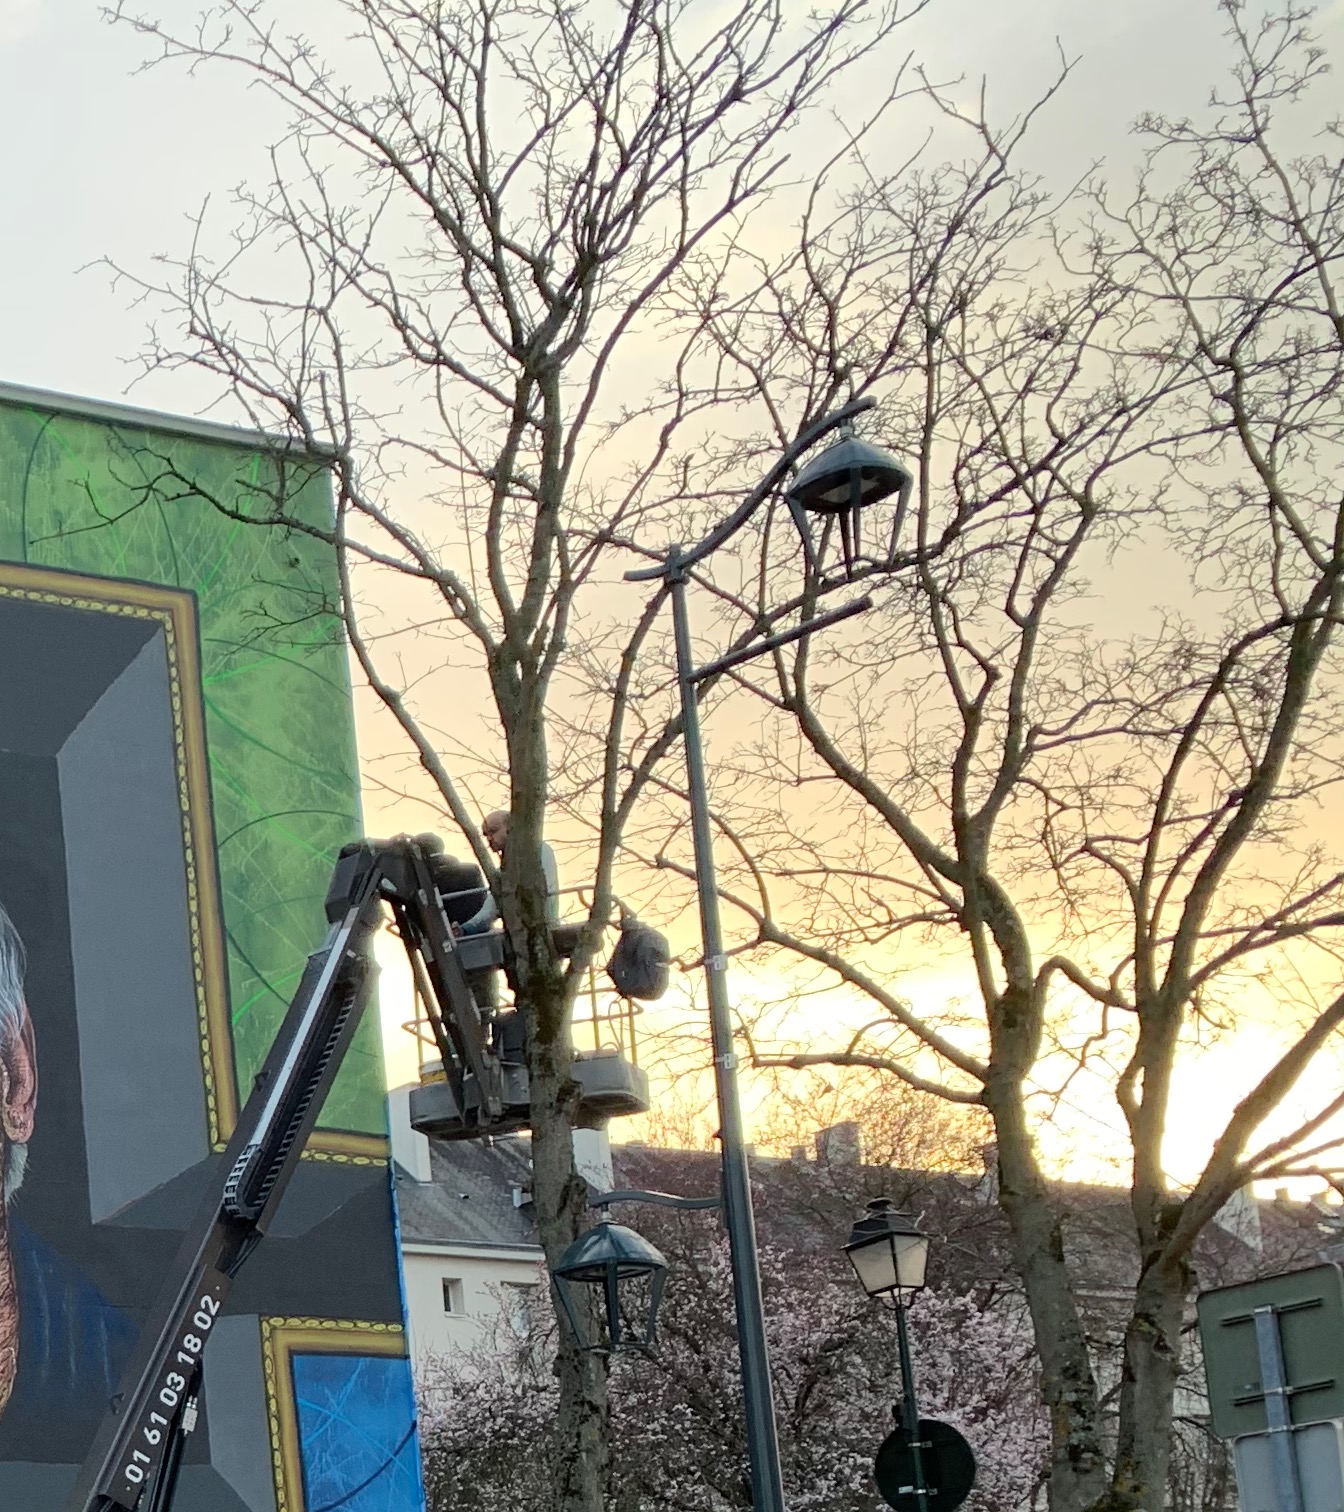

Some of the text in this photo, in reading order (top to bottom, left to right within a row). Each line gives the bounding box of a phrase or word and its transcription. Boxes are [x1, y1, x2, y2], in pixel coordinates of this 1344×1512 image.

[125, 1294, 221, 1484] 01 61 03 18 02
